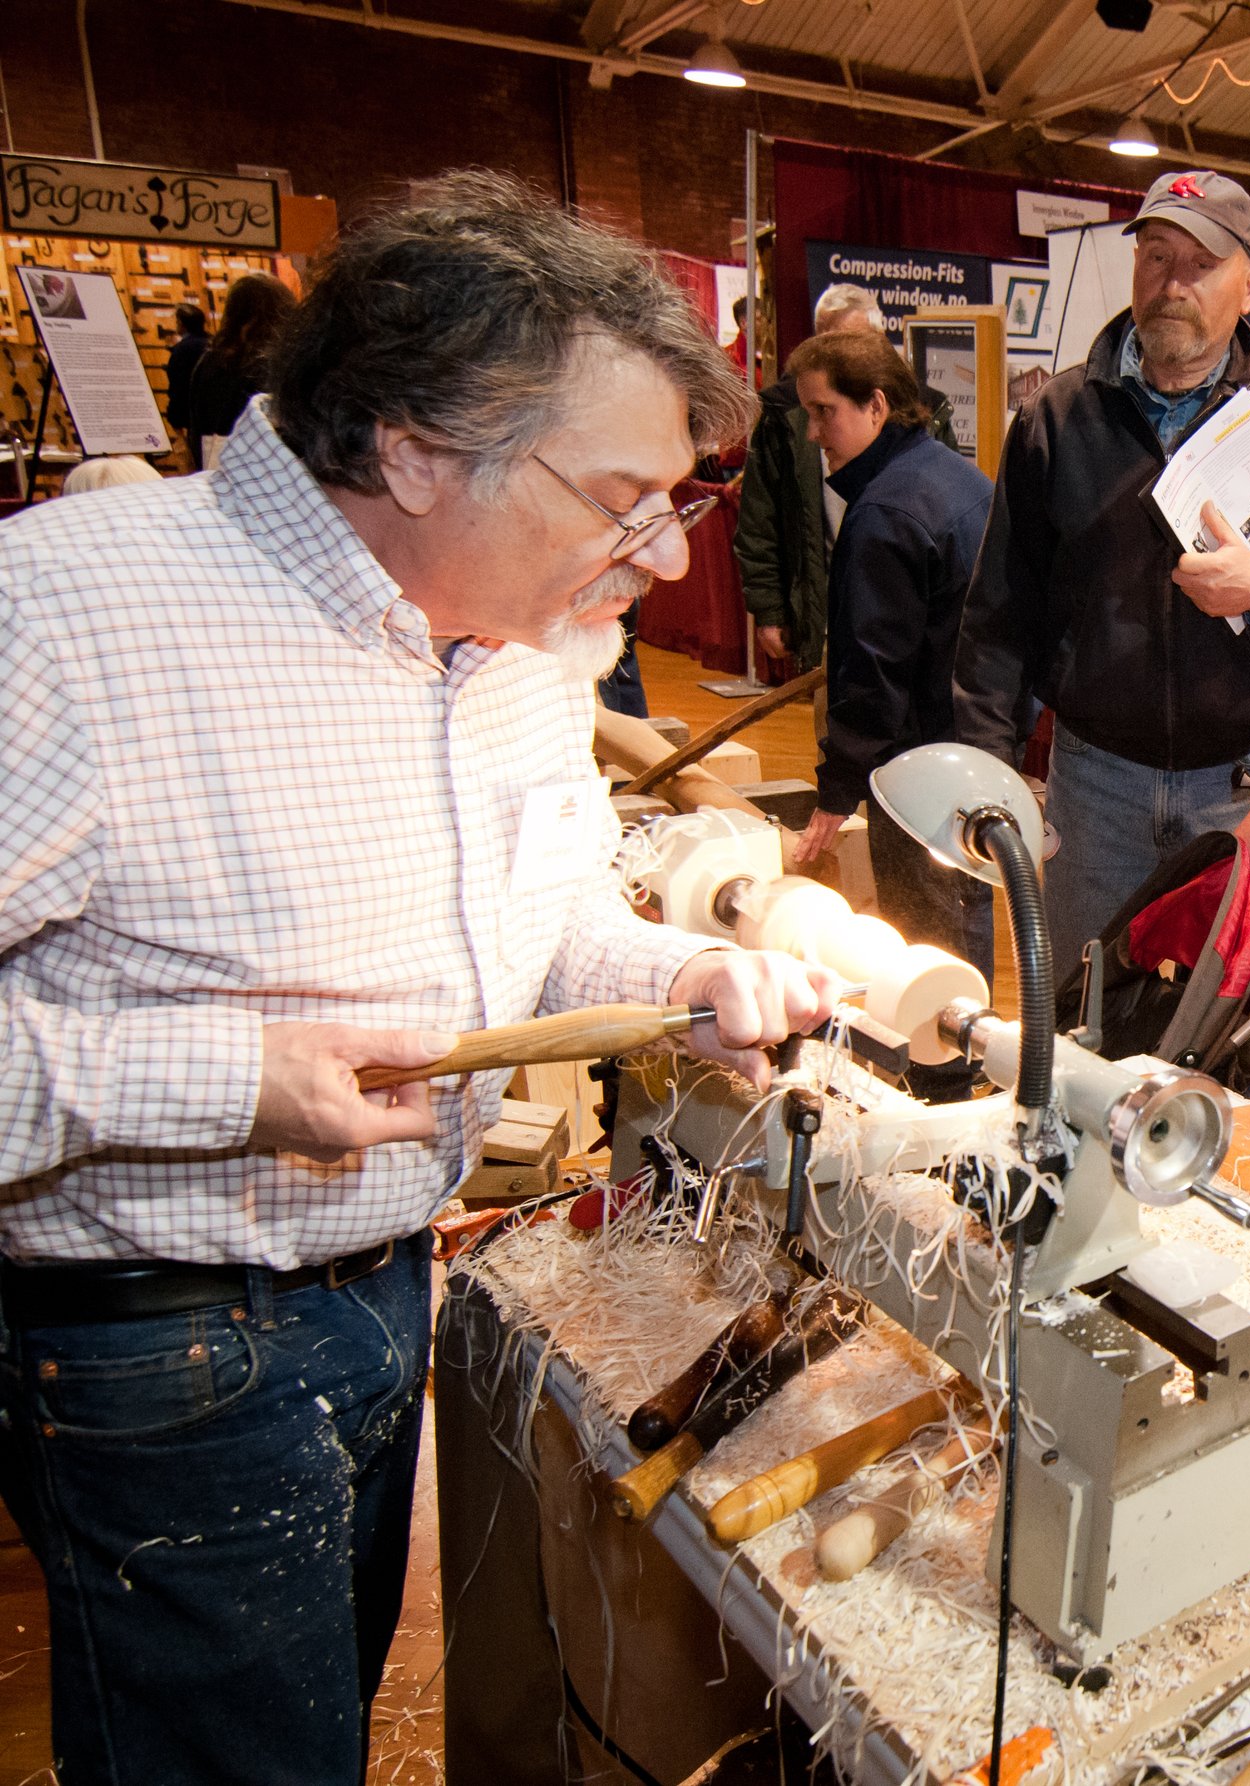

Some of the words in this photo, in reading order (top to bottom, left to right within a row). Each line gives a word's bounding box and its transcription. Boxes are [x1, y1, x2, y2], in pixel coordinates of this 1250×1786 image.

[6, 163, 150, 227] Fagan's
[169, 177, 272, 237] Forge
[829, 253, 965, 284] Compression-Fits
